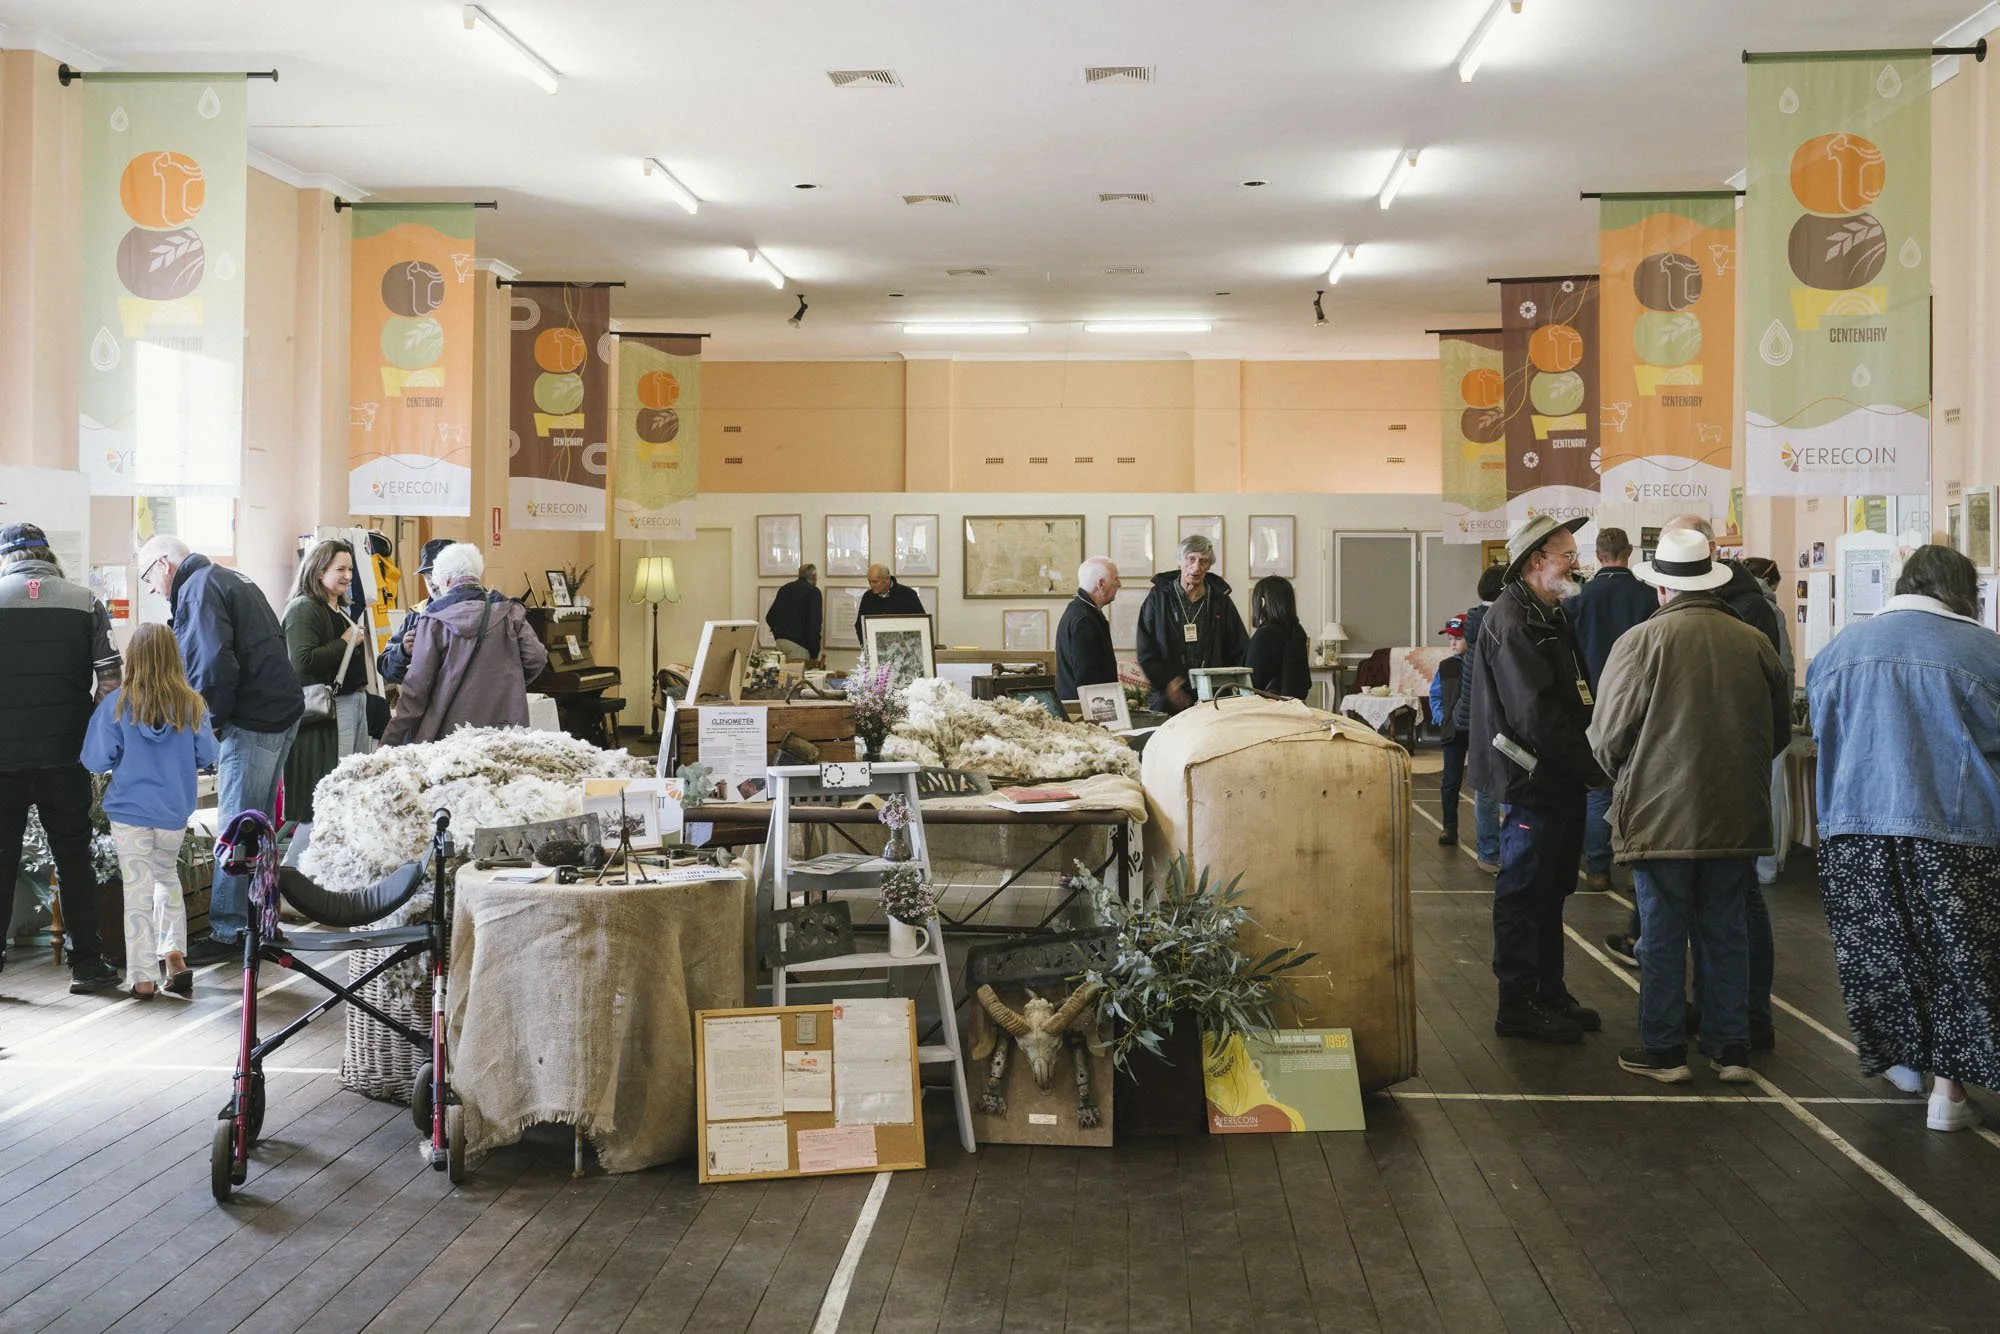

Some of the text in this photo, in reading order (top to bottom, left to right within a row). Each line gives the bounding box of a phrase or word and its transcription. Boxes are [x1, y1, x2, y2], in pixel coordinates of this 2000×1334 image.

[1829, 327, 1888, 344] CENTENARY
[406, 396, 444, 408] CENTENARY
[1661, 395, 1704, 408] CENTENARY
[553, 437, 584, 447] CENTENARY
[1552, 438, 1587, 449] CENTENARY
[1791, 447, 1897, 465] YERECOIN
[380, 481, 449, 494] YERECOIN
[1633, 484, 1708, 497] YERECOIN
[533, 502, 588, 514] YERECOIN
[636, 516, 681, 527] YERECOIN
[711, 717, 755, 726] CLINOMETER
[919, 771, 978, 793] MIA
